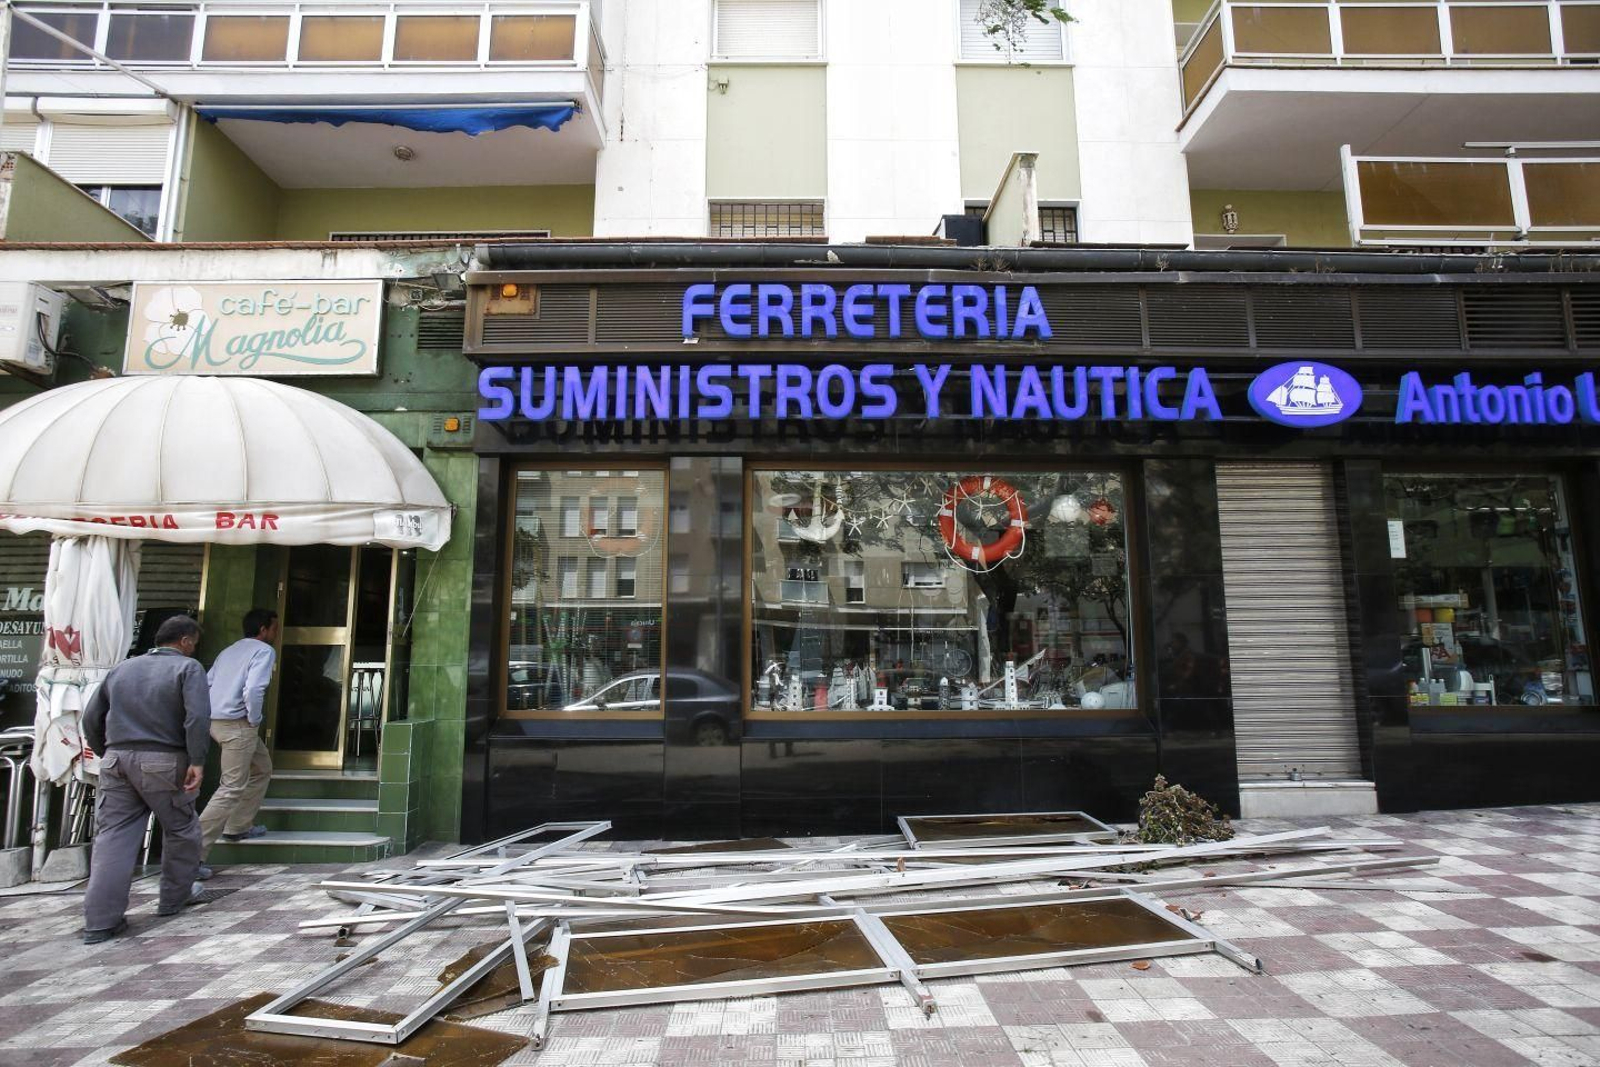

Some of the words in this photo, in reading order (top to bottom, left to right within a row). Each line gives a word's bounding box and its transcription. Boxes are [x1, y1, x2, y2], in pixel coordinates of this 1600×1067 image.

[219, 288, 370, 316] café-bar
[682, 284, 1053, 339] FERRETERIA
[144, 314, 367, 370] Magnolia
[478, 364, 899, 421] SUMINISTROS
[914, 364, 951, 420] Y
[970, 365, 1224, 421] NAUTICA
[1395, 371, 1574, 424] Antonio
[215, 511, 279, 530] BAR
[1, 587, 45, 612] Ma
[0, 669, 24, 678] NUDO
